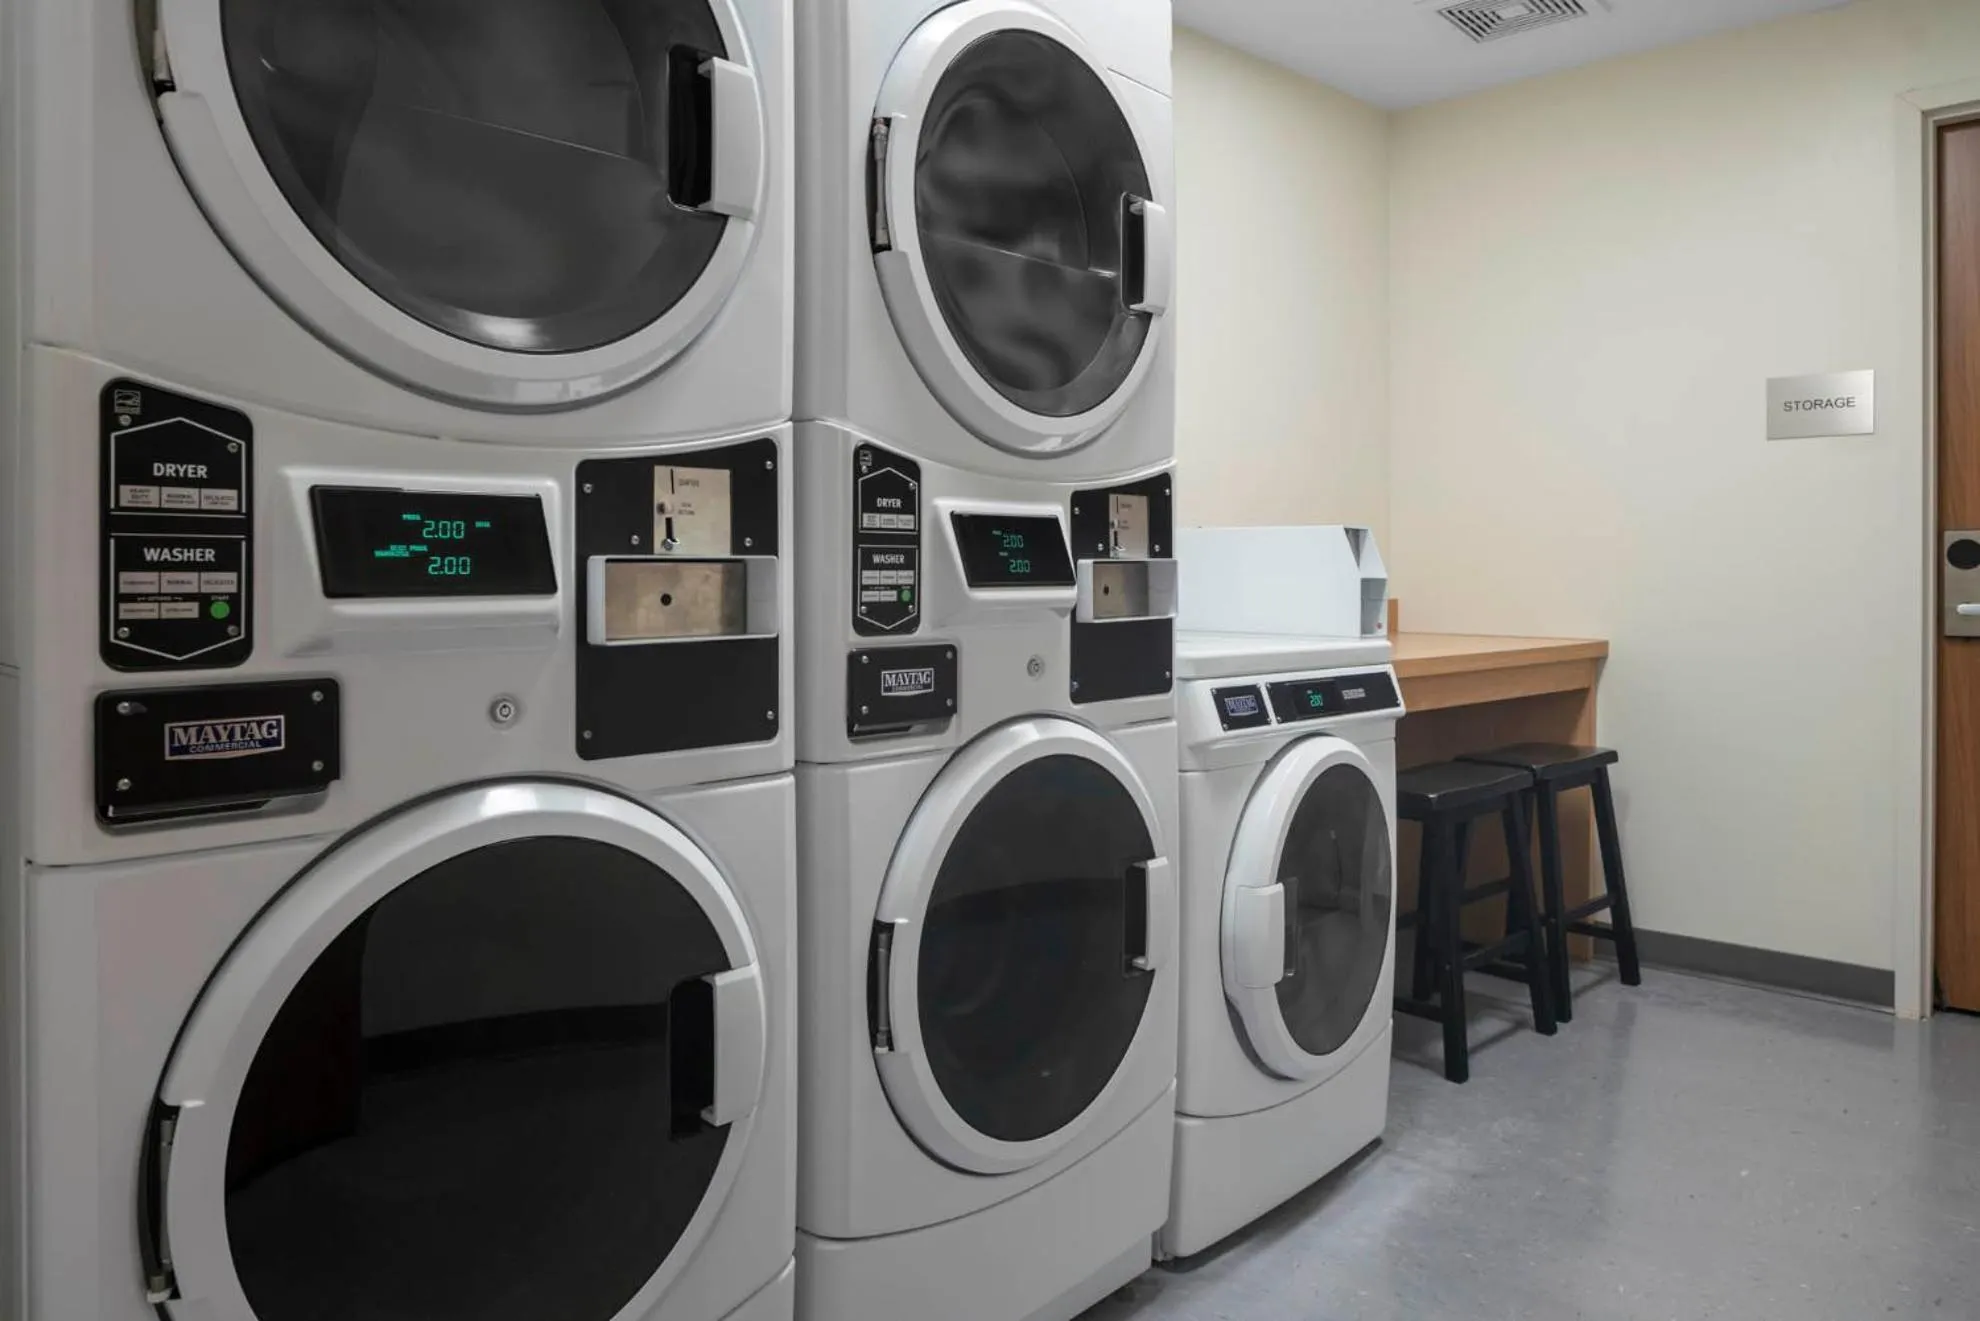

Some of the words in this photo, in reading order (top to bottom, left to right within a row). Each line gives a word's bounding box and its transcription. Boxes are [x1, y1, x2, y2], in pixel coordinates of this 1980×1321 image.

[1783, 396, 1857, 412] STORAGE
[153, 462, 208, 479] DRYER
[877, 498, 902, 509] DRYER
[423, 520, 465, 539] 2.00
[143, 547, 216, 562] WASHER
[872, 553, 905, 565] WASHER
[428, 556, 471, 575] 2.00
[884, 671, 931, 688] MAYTAG
[172, 720, 278, 746] MAYTAG
[189, 740, 262, 754] COMMERCIAL
